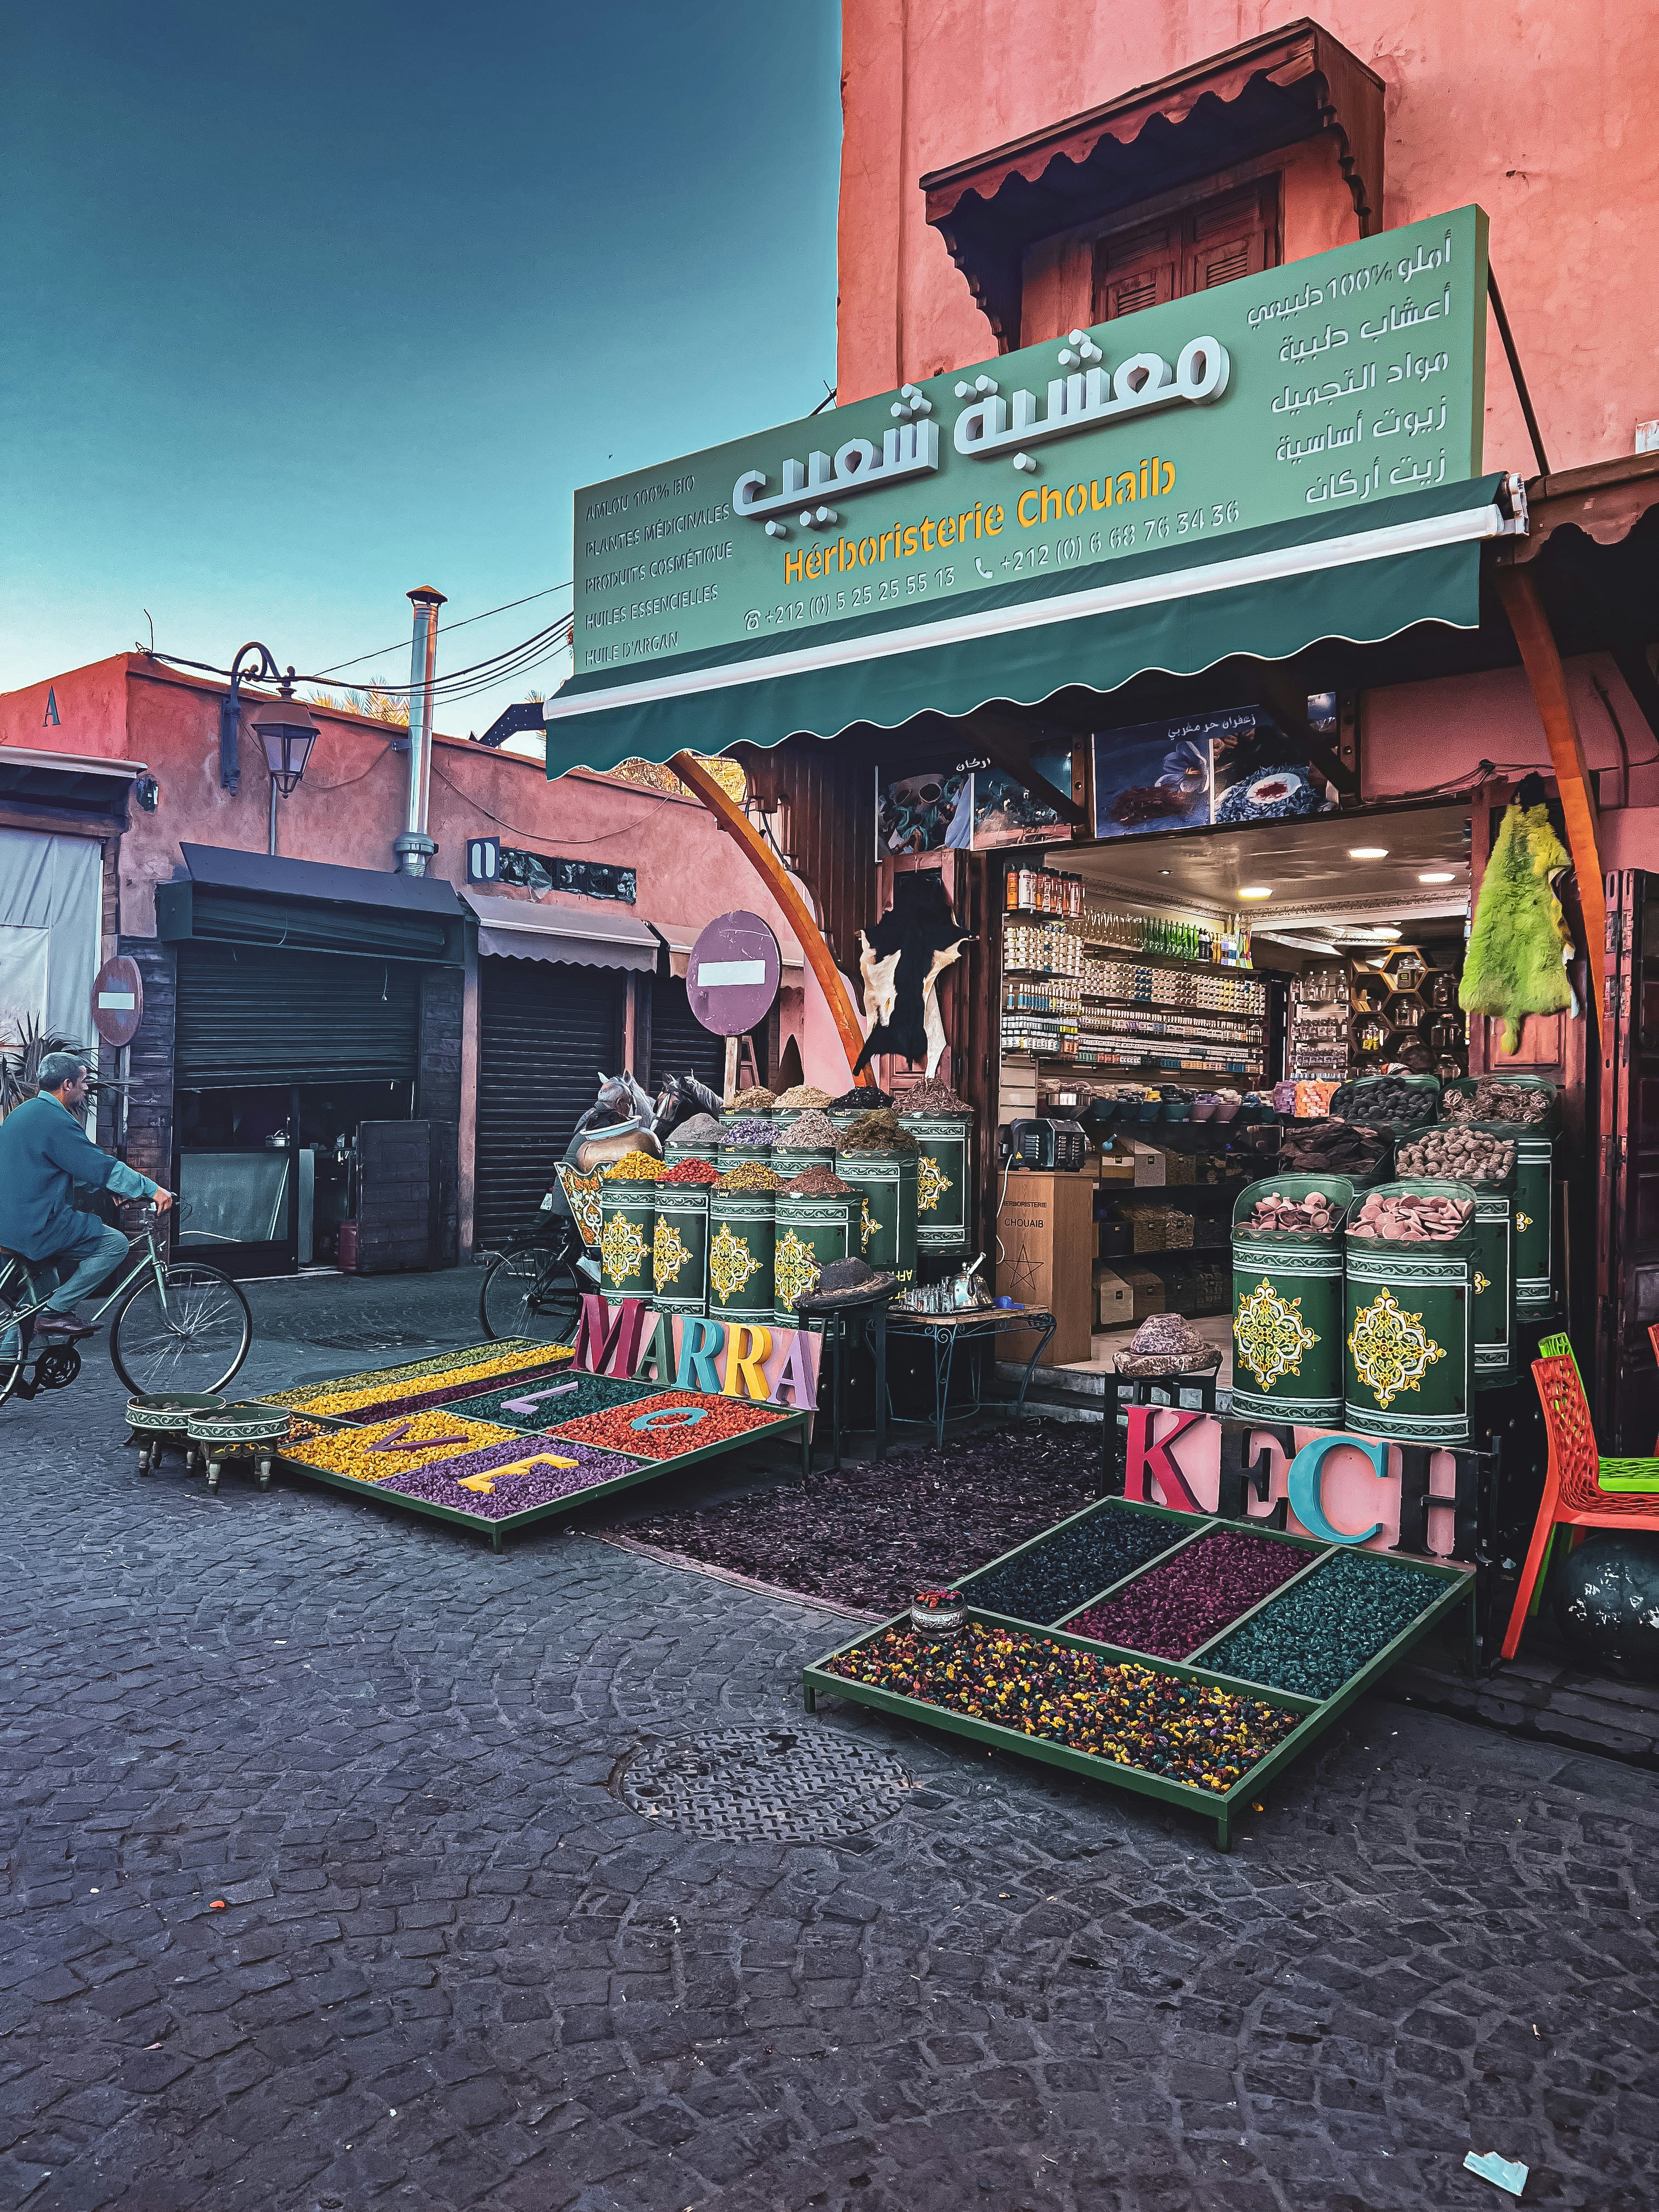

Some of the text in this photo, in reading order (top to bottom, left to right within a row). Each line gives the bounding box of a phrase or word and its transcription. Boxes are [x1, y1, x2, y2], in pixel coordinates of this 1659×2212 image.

[1248, 229, 1452, 330] أملو 100% طبيعي
[1279, 281, 1451, 365] أعشاب طبية
[1271, 351, 1449, 416] مواد التجميل
[732, 329, 1231, 539] معشبة شعيب
[1276, 395, 1447, 465] زيوت أساسية
[585, 474, 695, 522] AMLOU 100% BIO
[1305, 448, 1446, 504] زيت أركان
[585, 503, 730, 558] PLANTES MÉDICINALES
[784, 456, 1176, 585] Hérboristerie Chouaib
[1001, 500, 1239, 571] +212 (0) 6 68 76 34 36
[585, 540, 733, 594] PRODUITS COSMÉTIQUE
[765, 565, 956, 624] +212 (0) 5 25 25 55 13
[585, 584, 719, 630] HUILES ESSENCIELLES
[585, 631, 679, 667] HUILE D'ARGAN
[42, 685, 61, 727] A
[1168, 714, 1256, 741] زعفران حر مغربي
[1004, 1218, 1044, 1228] CHOUAIB
[569, 1293, 821, 1412] MARRA
[1120, 1403, 1494, 1566] KECH
